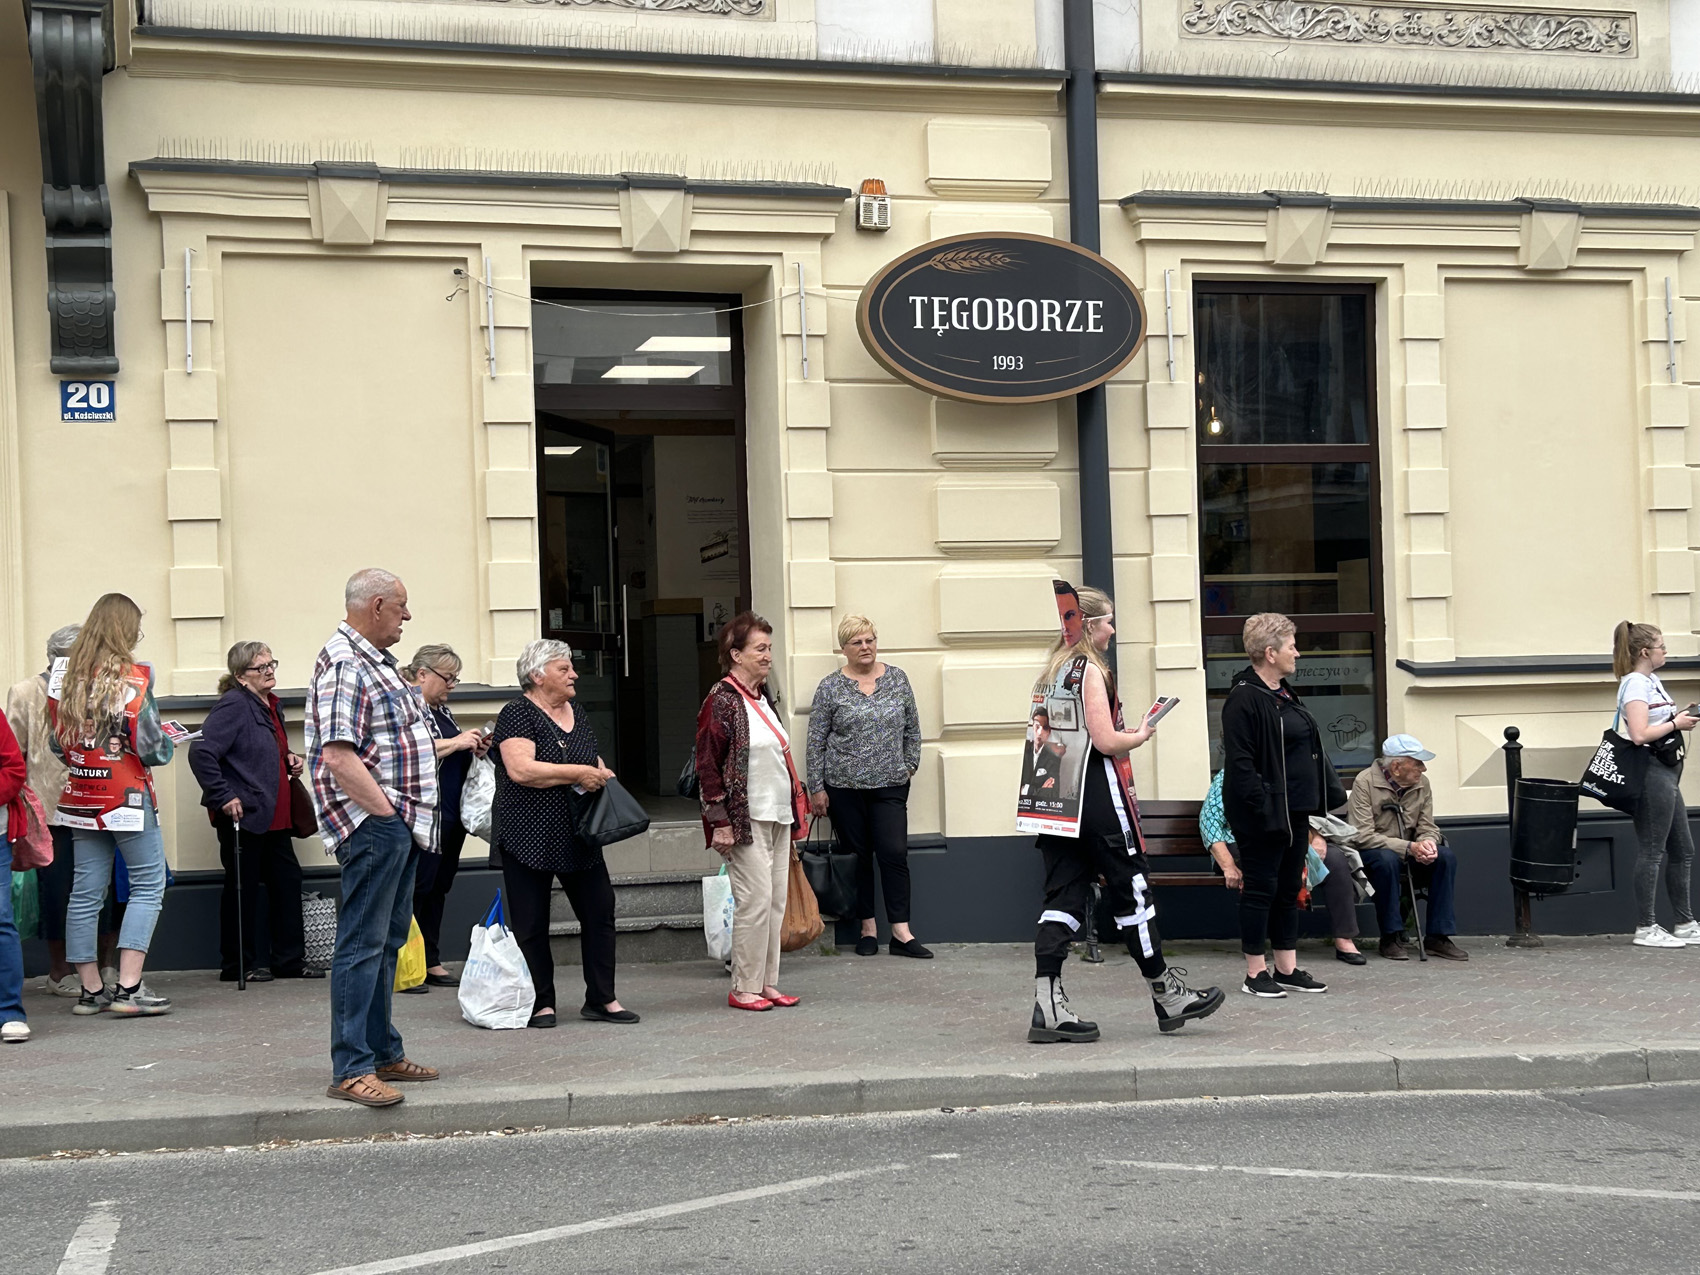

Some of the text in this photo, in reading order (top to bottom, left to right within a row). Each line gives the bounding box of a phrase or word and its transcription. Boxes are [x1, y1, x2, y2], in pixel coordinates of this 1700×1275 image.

[909, 296, 1104, 337] TĘGOBORZE
[992, 355, 1024, 371] 1993
[67, 382, 110, 408] 20
[63, 411, 113, 420] ul. Kościuszki
[1295, 664, 1350, 681] pieczywo
[1588, 763, 1625, 785] REPEAT.
